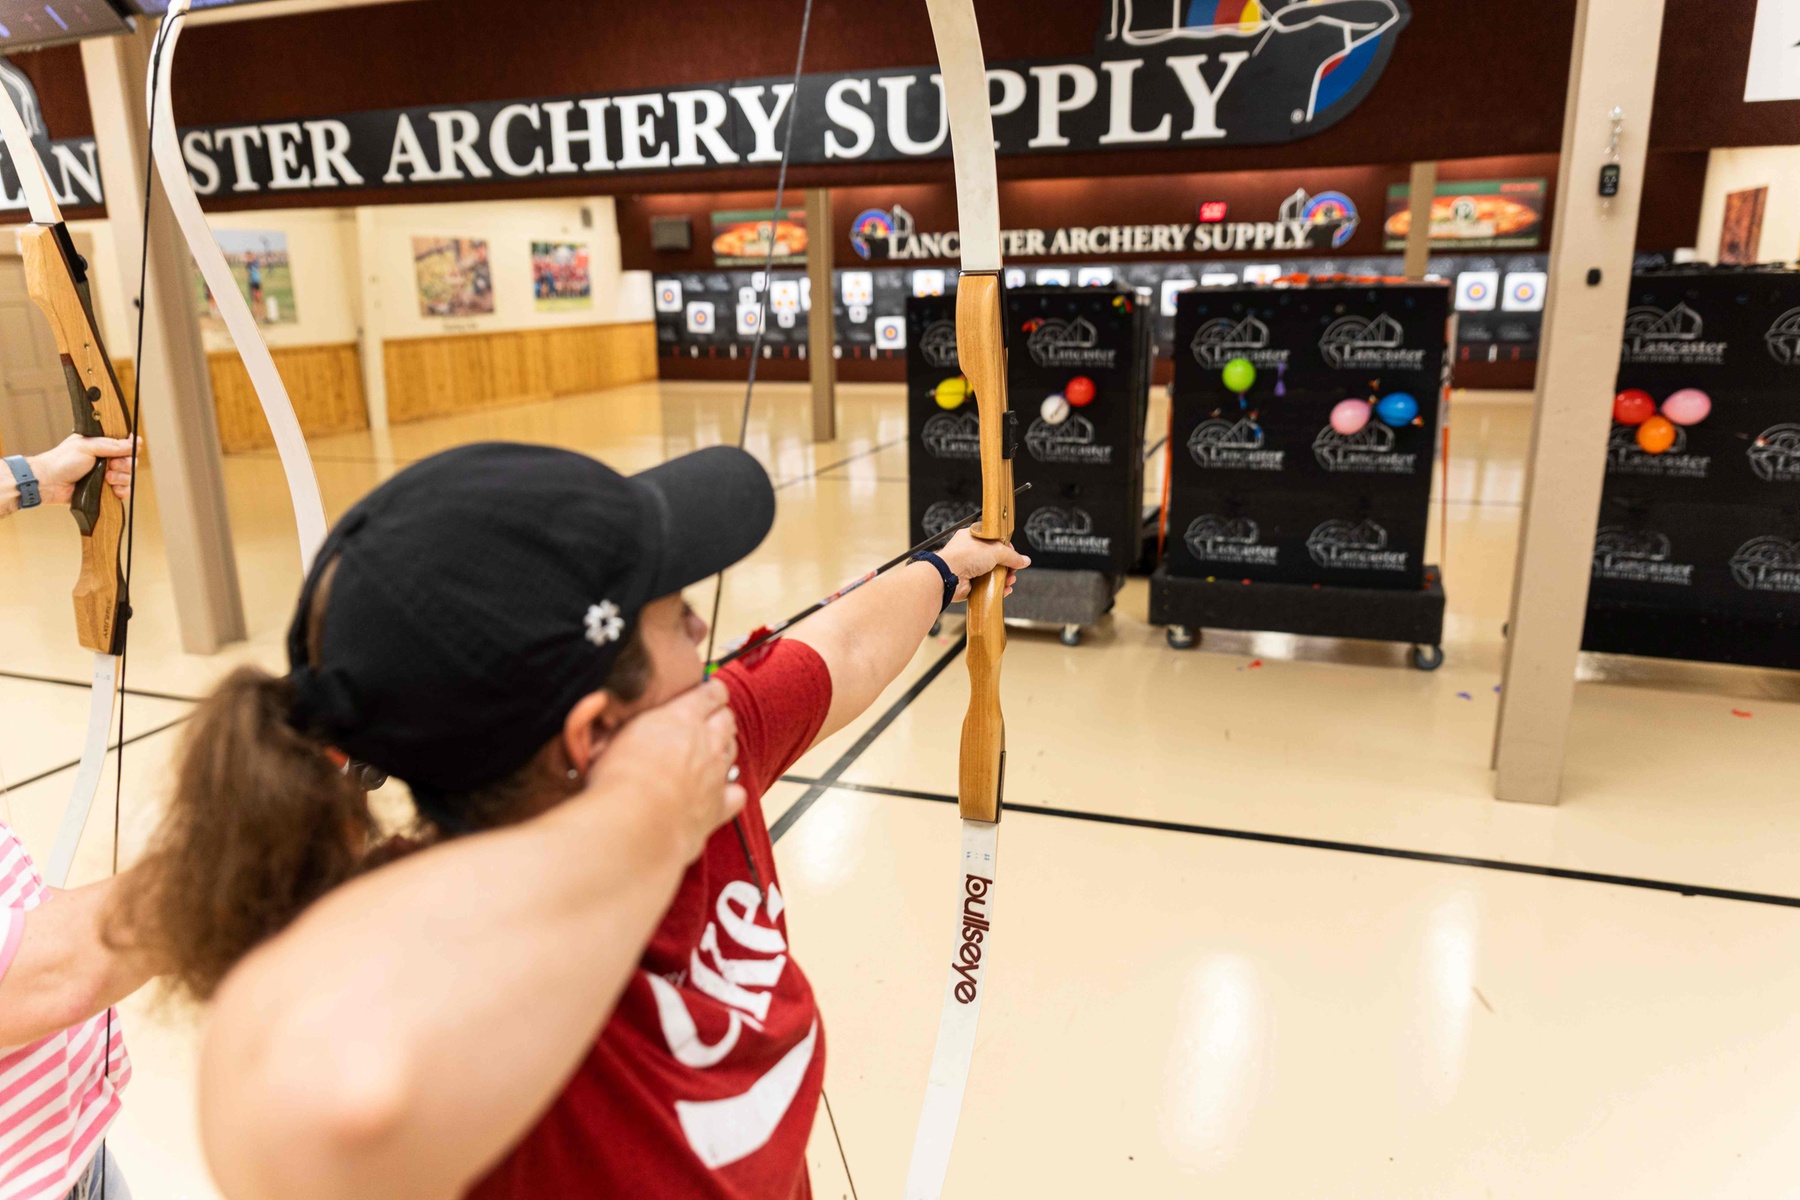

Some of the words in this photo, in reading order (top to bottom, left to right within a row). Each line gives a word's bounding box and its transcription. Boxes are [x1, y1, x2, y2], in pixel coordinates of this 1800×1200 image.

[383, 84, 797, 183] ARCHERY
[1051, 224, 1191, 255] ARCHERY
[1193, 219, 1312, 252] SUPPLY
[645, 880, 787, 1068] Cke
[952, 874, 993, 1005] bullseye
